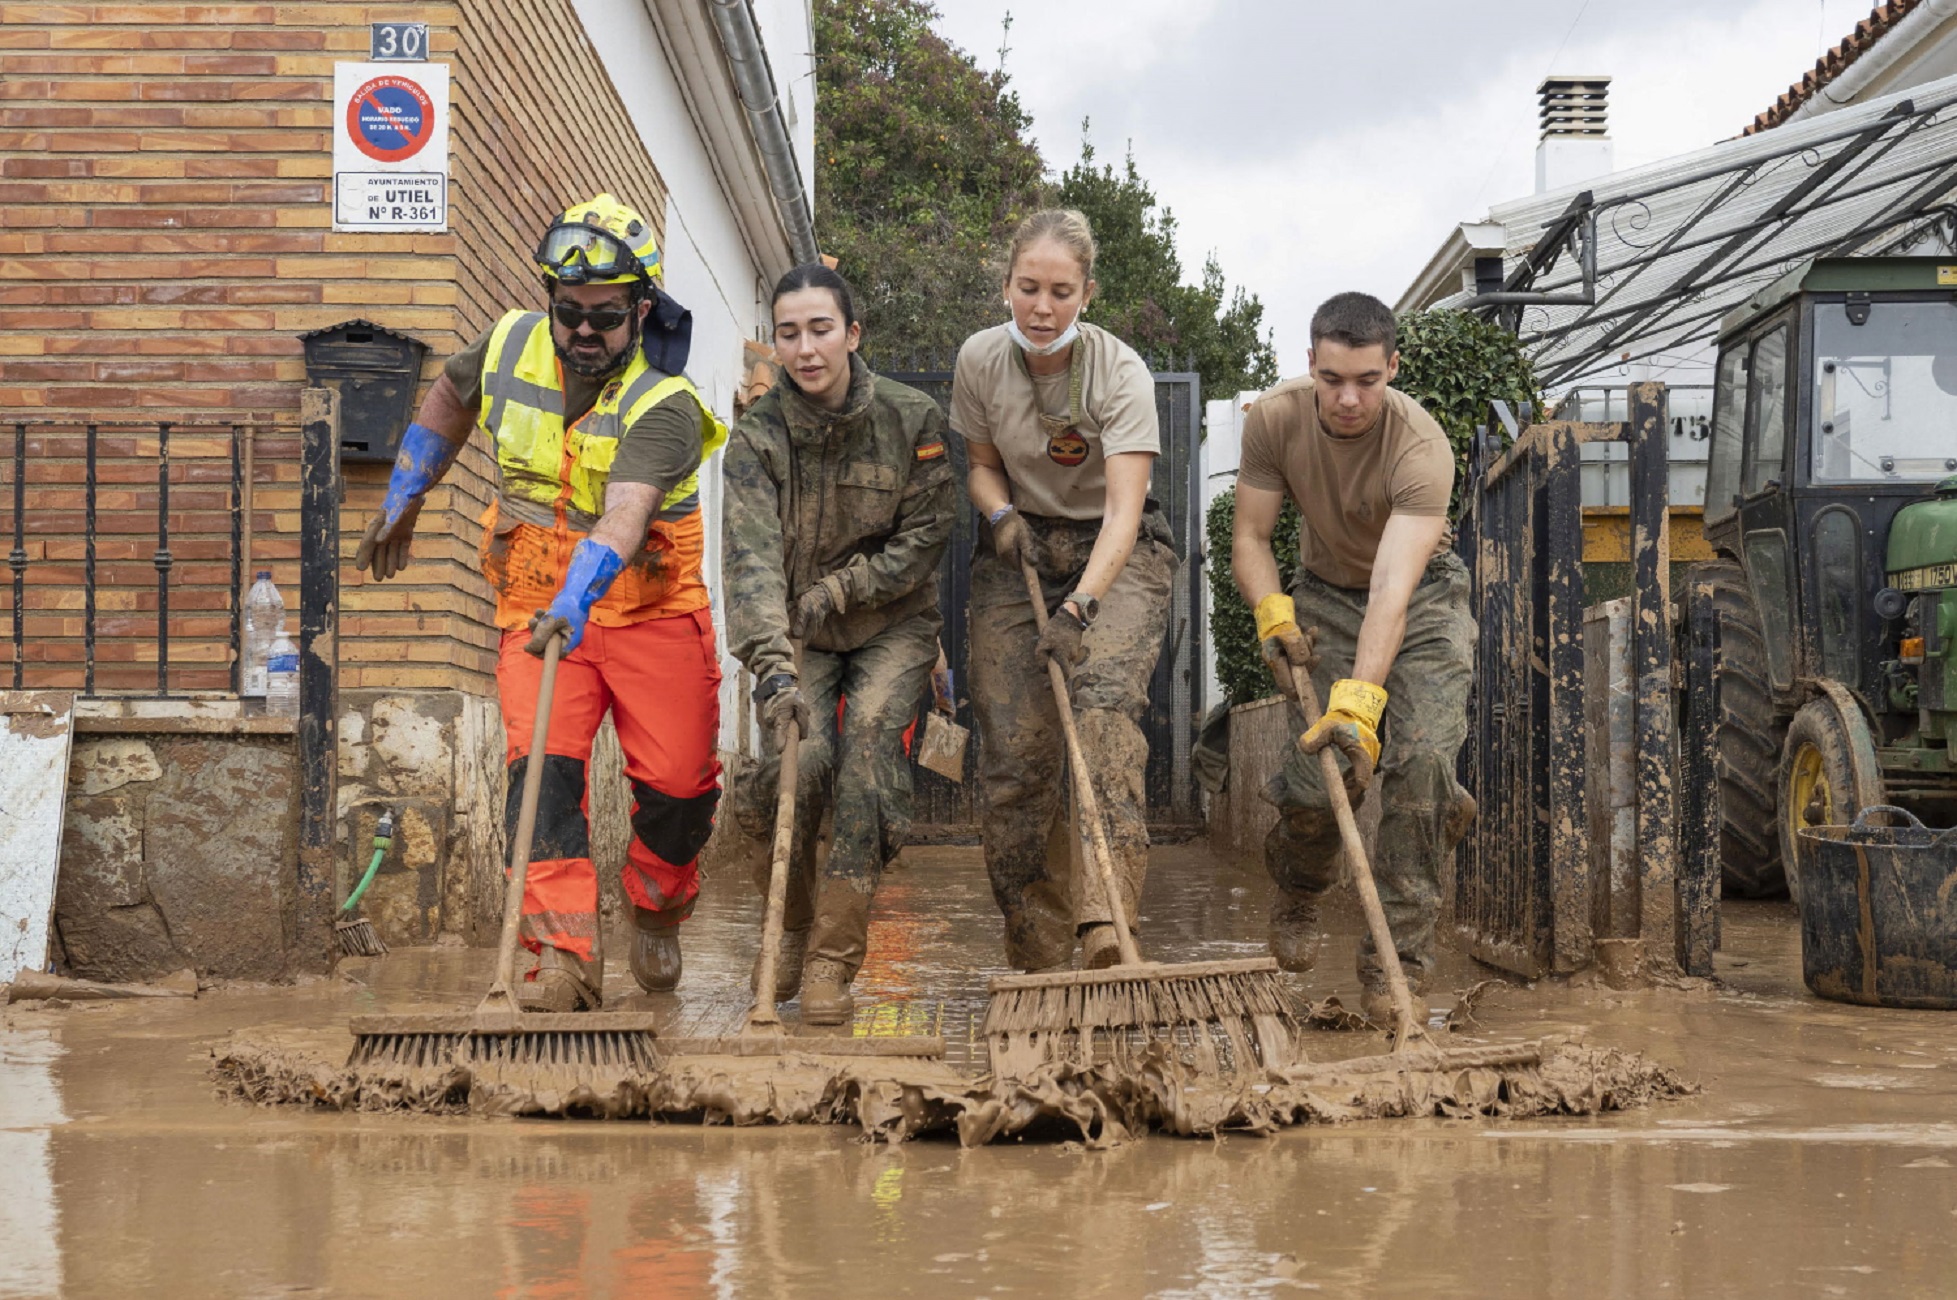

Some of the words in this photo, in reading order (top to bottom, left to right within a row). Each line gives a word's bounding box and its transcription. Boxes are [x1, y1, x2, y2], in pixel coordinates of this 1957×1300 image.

[379, 26, 420, 56] 30
[354, 82, 377, 104] SALIDA
[378, 79, 390, 87] DE
[377, 106, 402, 114] VADO
[368, 178, 439, 186] AYUNTAMIENTO
[385, 189, 434, 203] UTIEL
[391, 206, 436, 220] R-361
